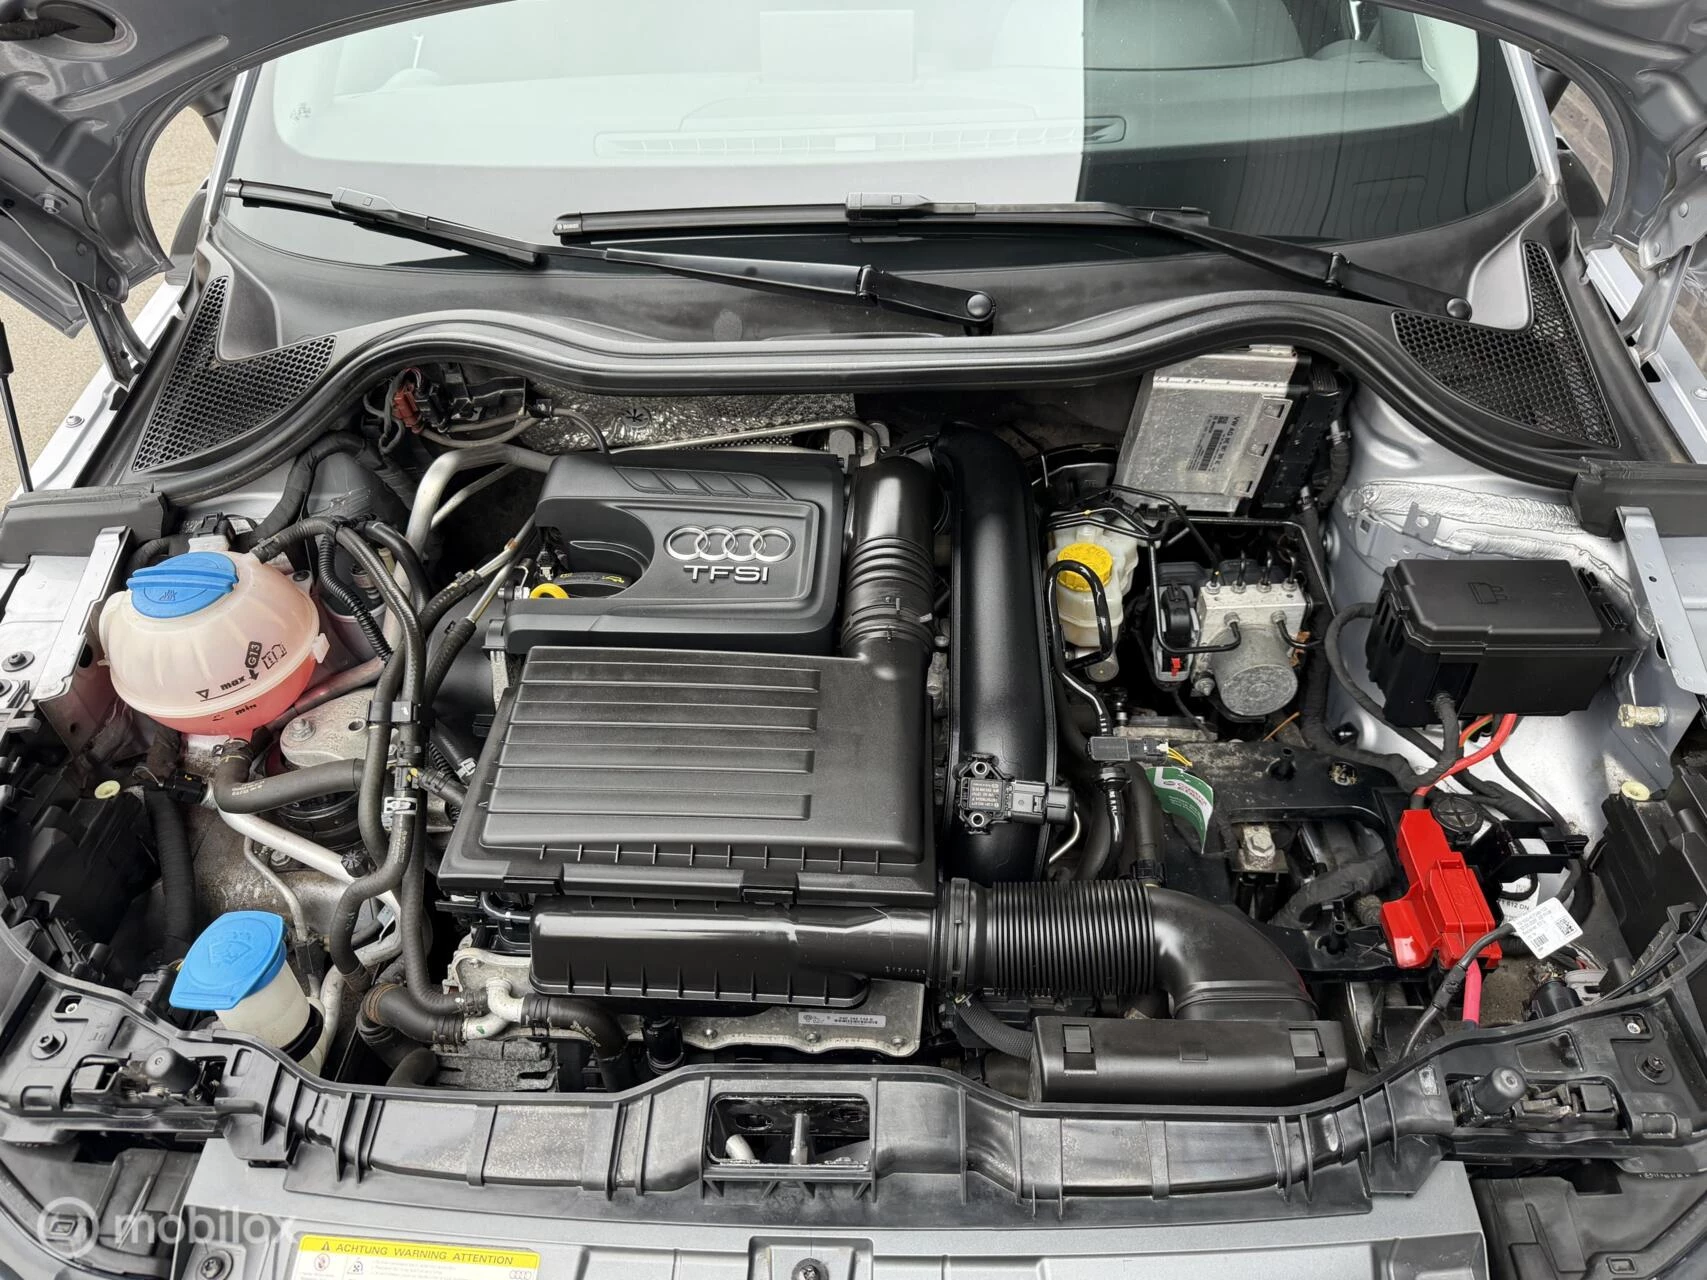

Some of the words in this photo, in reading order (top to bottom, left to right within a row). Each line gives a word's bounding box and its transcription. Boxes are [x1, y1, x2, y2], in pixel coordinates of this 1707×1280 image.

[1231, 416, 1240, 426] VW
[683, 565, 769, 584] TFSI
[247, 642, 261, 667] G13
[220, 676, 246, 691] max
[235, 704, 257, 716] min
[336, 1243, 388, 1256] ACHTUNG
[394, 1248, 448, 1261] WARNING
[453, 1252, 513, 1265] ATTENTION
